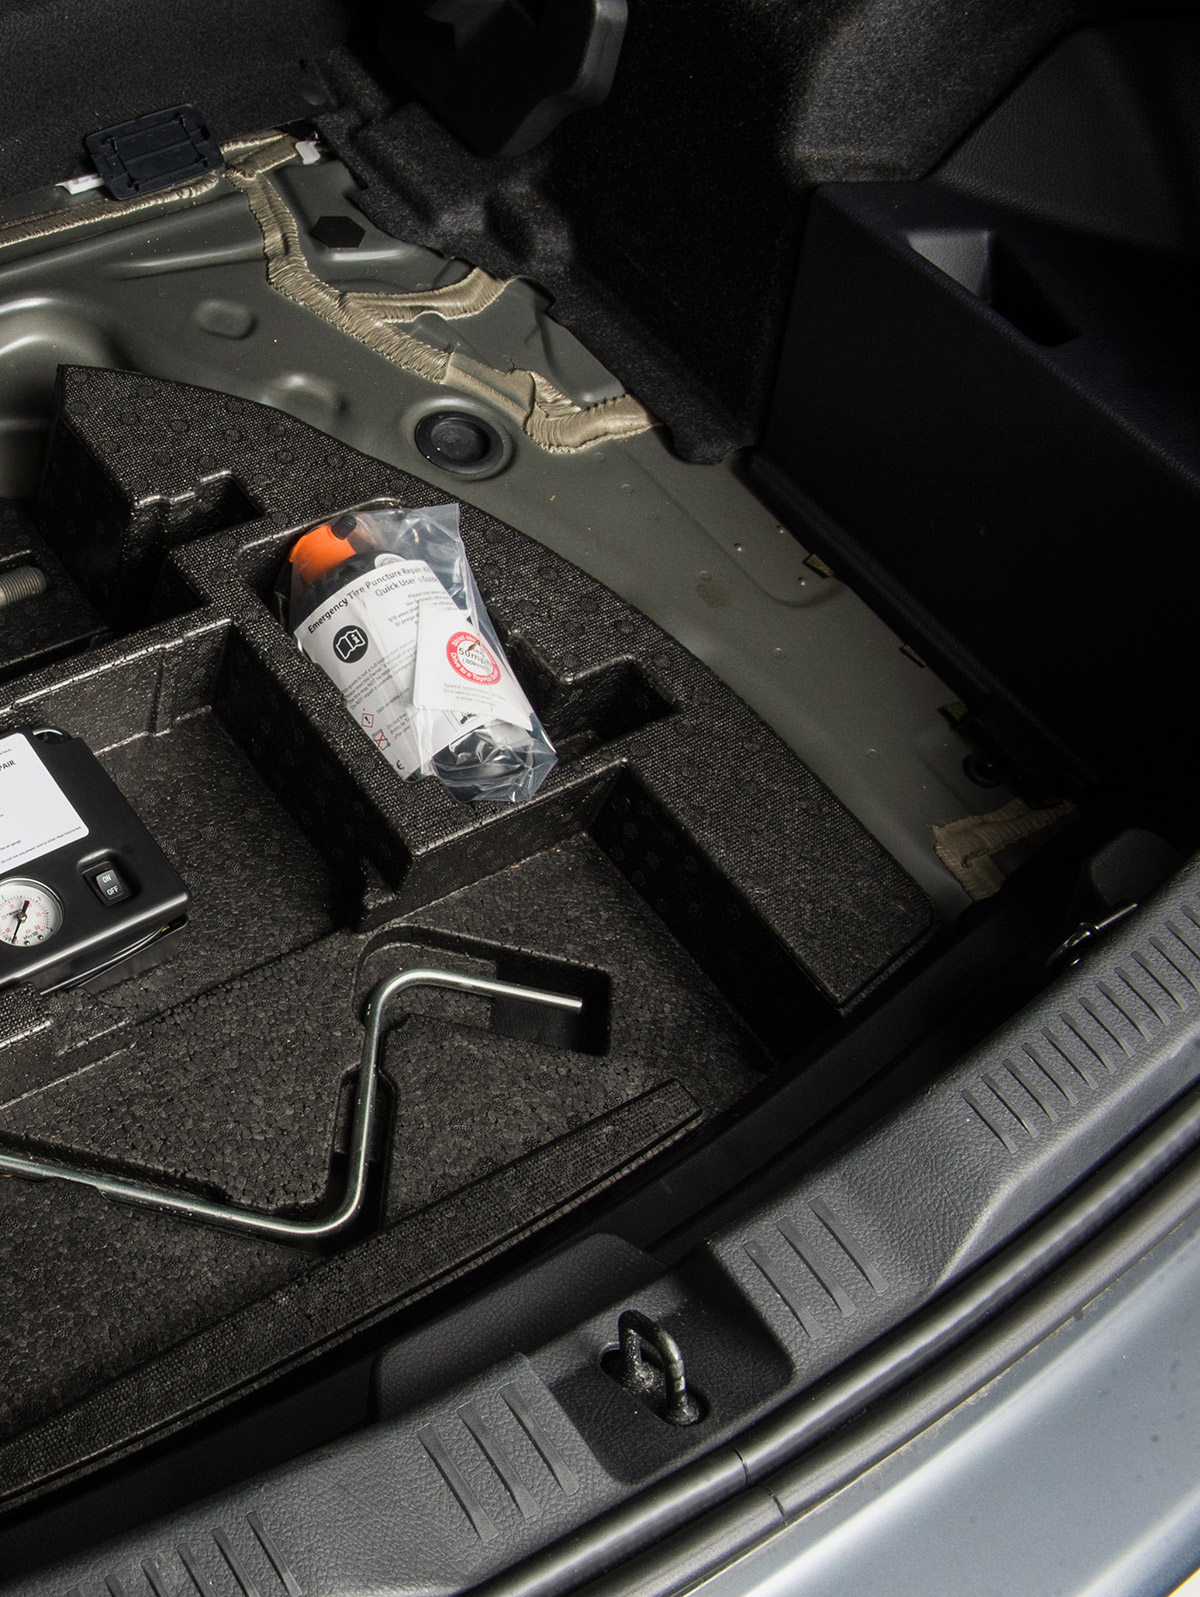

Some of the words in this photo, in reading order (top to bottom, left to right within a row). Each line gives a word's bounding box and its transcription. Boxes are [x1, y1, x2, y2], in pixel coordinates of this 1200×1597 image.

[375, 582, 400, 597] Quick
[308, 597, 348, 634] Emergency
[347, 586, 366, 600] Tire
[366, 570, 402, 590] Puncture
[450, 652, 460, 668] Drive
[102, 874, 112, 883] ON
[107, 886, 118, 896] OFF
